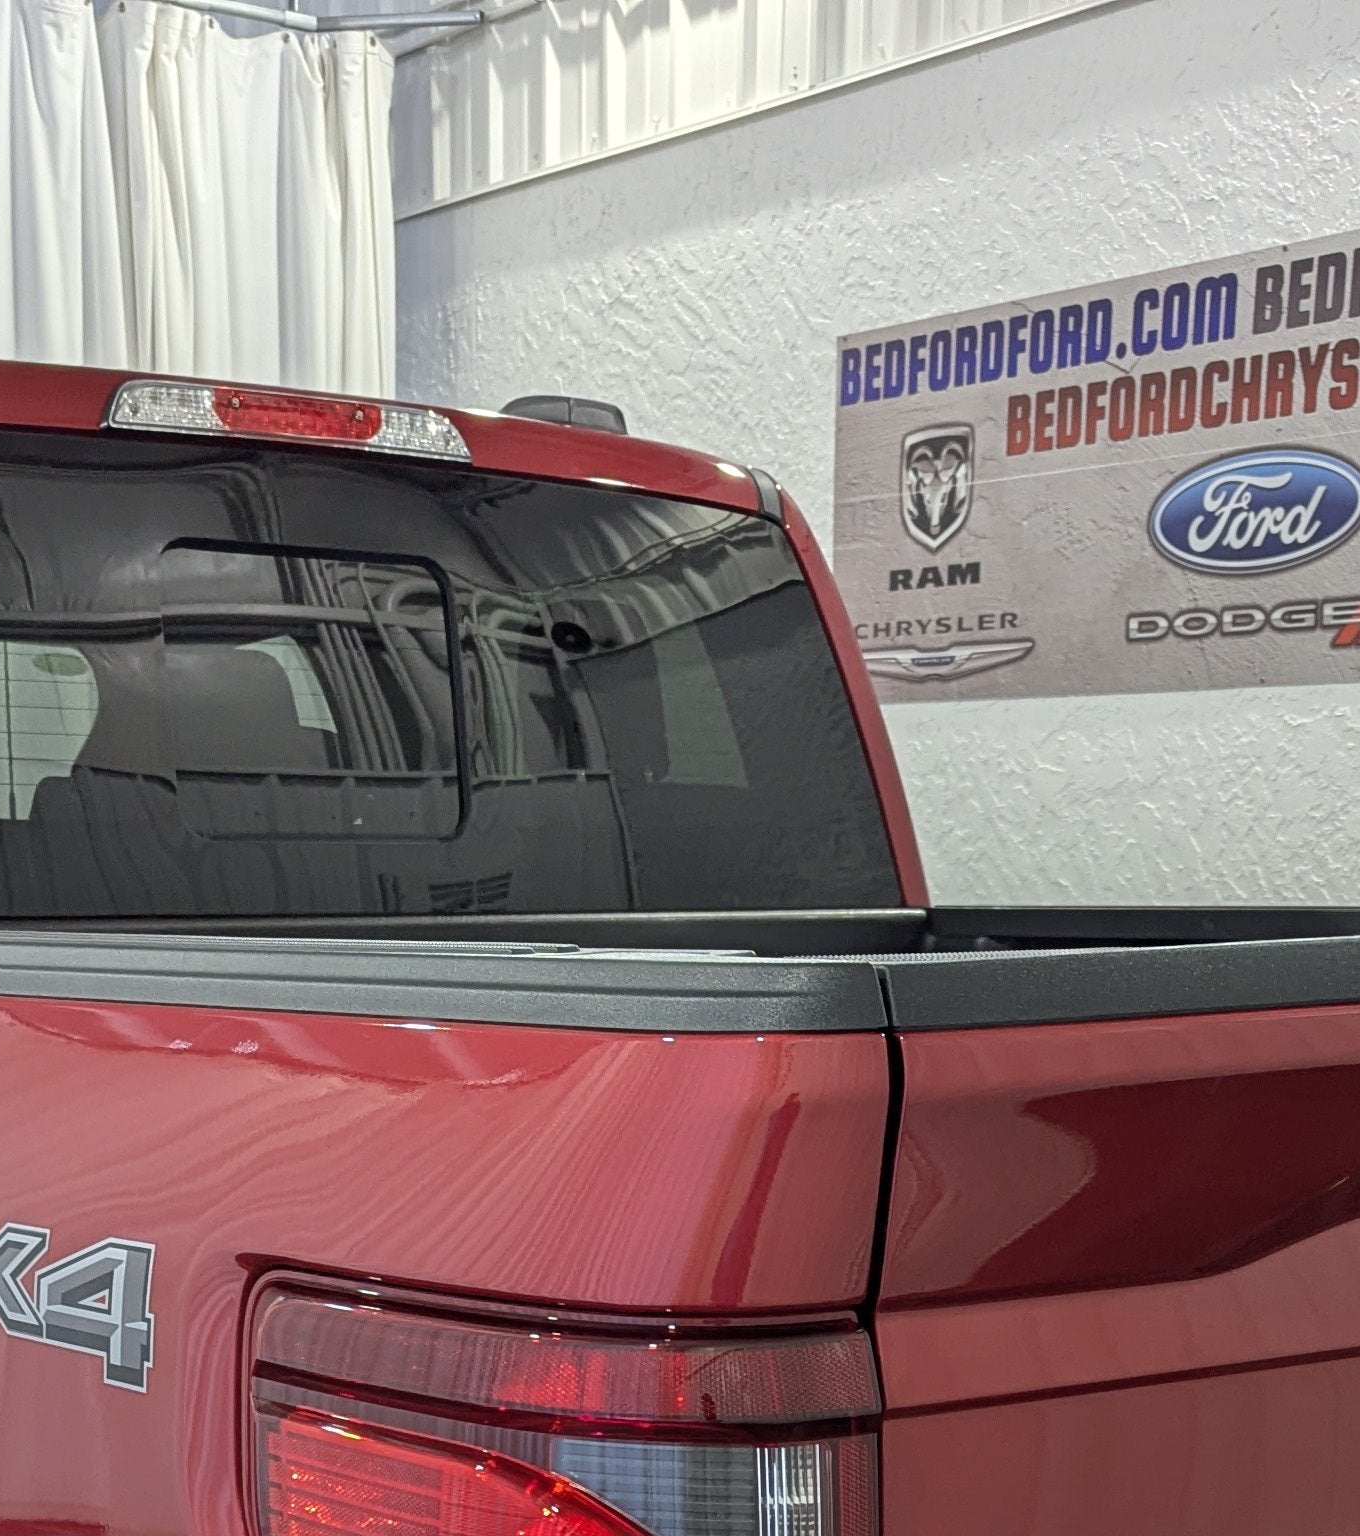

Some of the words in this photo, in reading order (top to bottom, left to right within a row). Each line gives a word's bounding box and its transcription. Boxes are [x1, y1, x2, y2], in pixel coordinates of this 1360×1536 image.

[840, 273, 1238, 406] BEDFORDFORD.COM
[1188, 472, 1327, 552] Ford
[889, 562, 981, 592] RAM
[855, 612, 1019, 639] CHRYSLER
